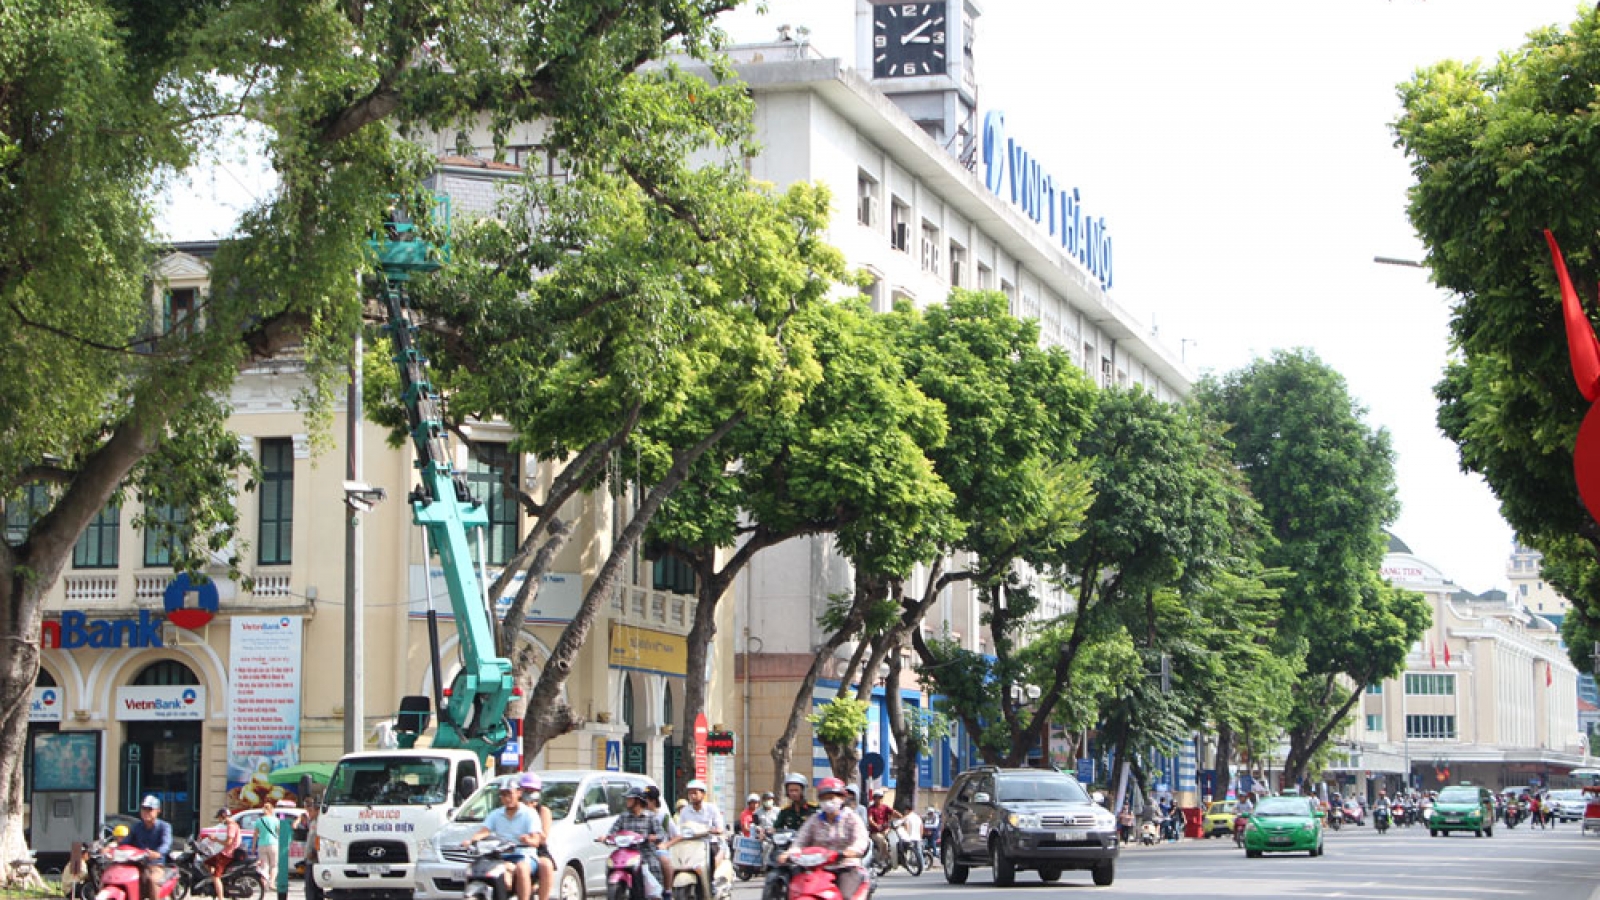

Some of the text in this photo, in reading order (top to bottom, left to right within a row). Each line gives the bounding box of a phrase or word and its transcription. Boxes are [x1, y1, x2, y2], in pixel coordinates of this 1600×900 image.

[902, 4, 917, 17] 12
[875, 35, 887, 48] 9
[933, 31, 945, 44] 3
[903, 63, 916, 75] 6
[1007, 137, 1059, 236] VNPT
[1379, 567, 1400, 576] RANG
[41, 610, 163, 650] nBank
[125, 697, 182, 711] VietinBank
[343, 823, 353, 833] XE
